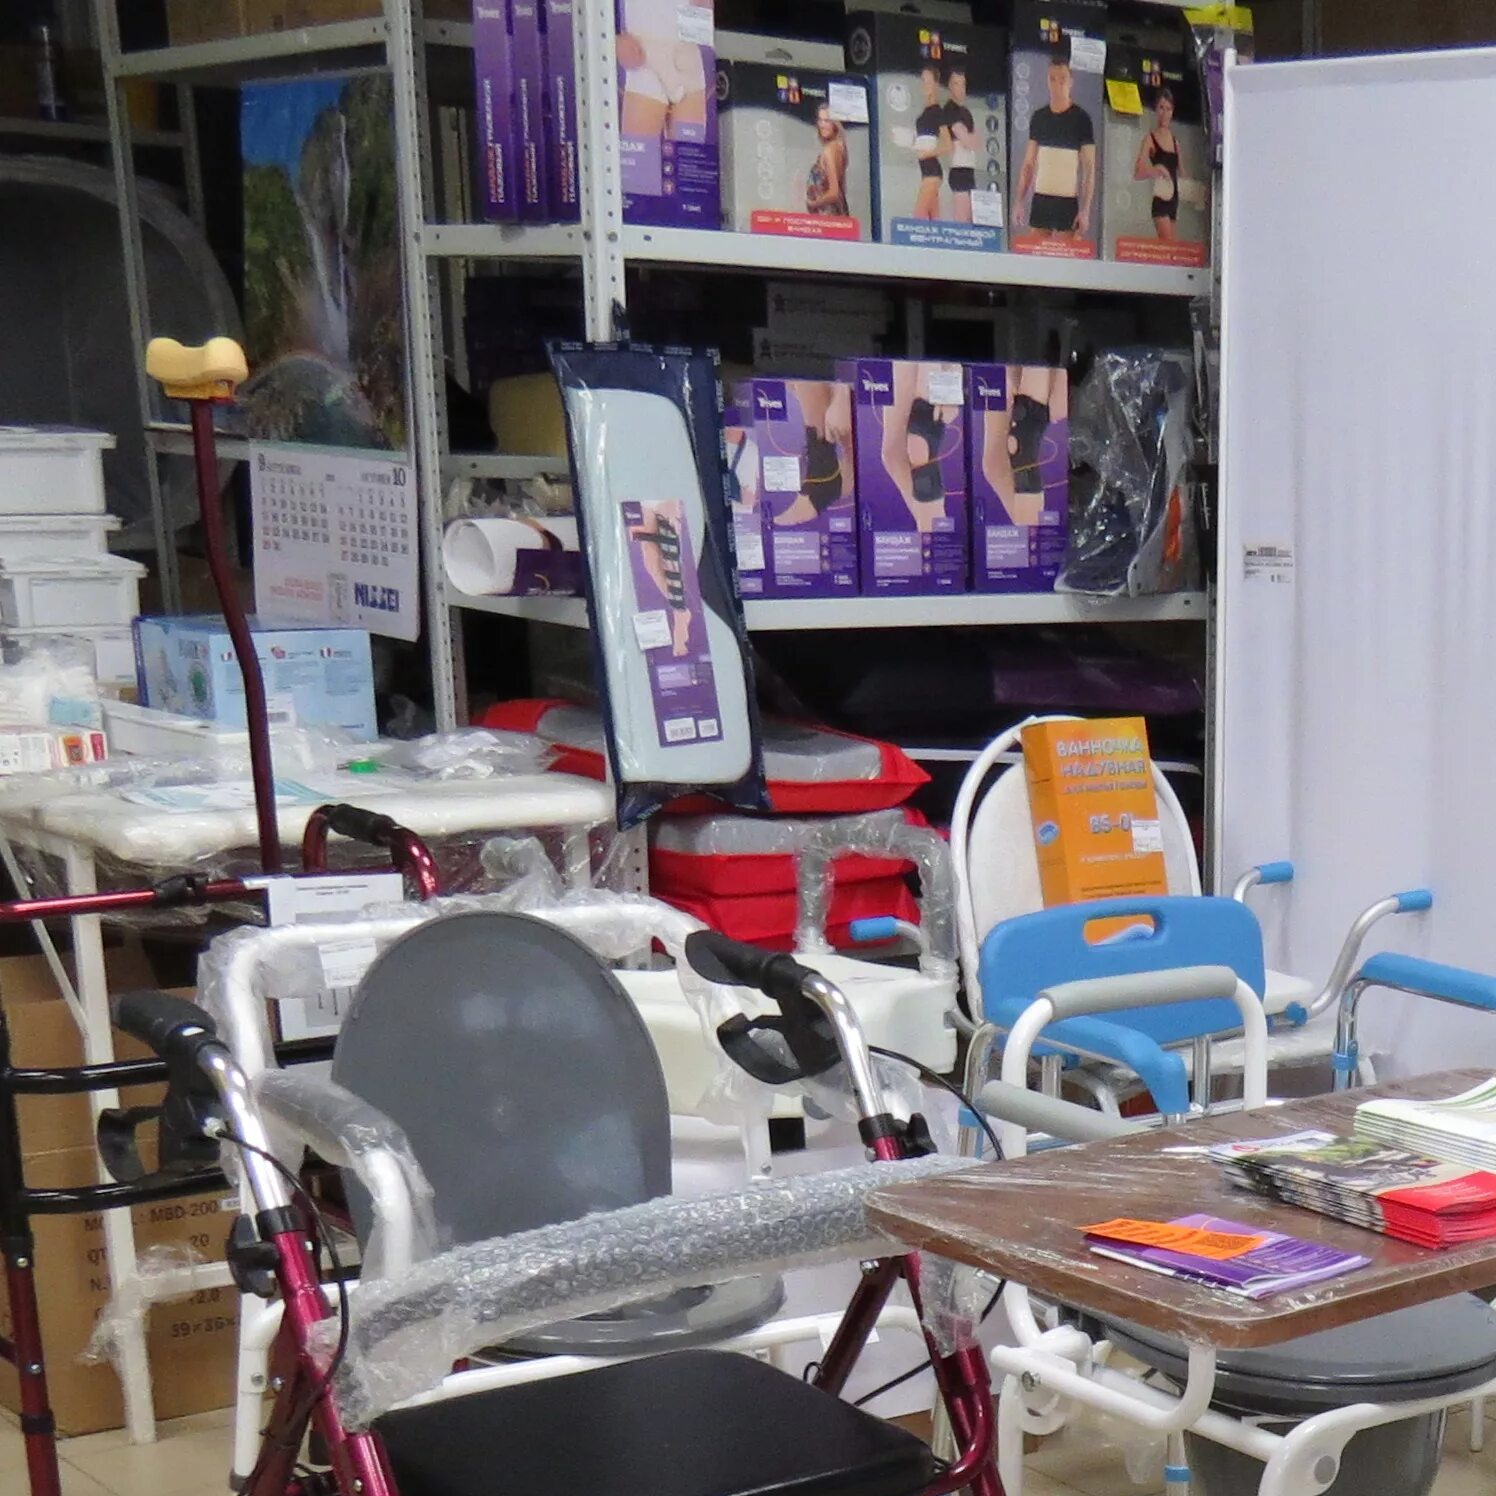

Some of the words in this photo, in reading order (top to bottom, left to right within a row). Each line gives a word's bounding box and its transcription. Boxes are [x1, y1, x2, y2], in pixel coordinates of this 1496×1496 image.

[1055, 736, 1143, 757] ВАННОЧКА
[1063, 759, 1145, 778] НАДУВНАЯ
[150, 1200, 219, 1222] MBD-200
[191, 1234, 210, 1248] 20
